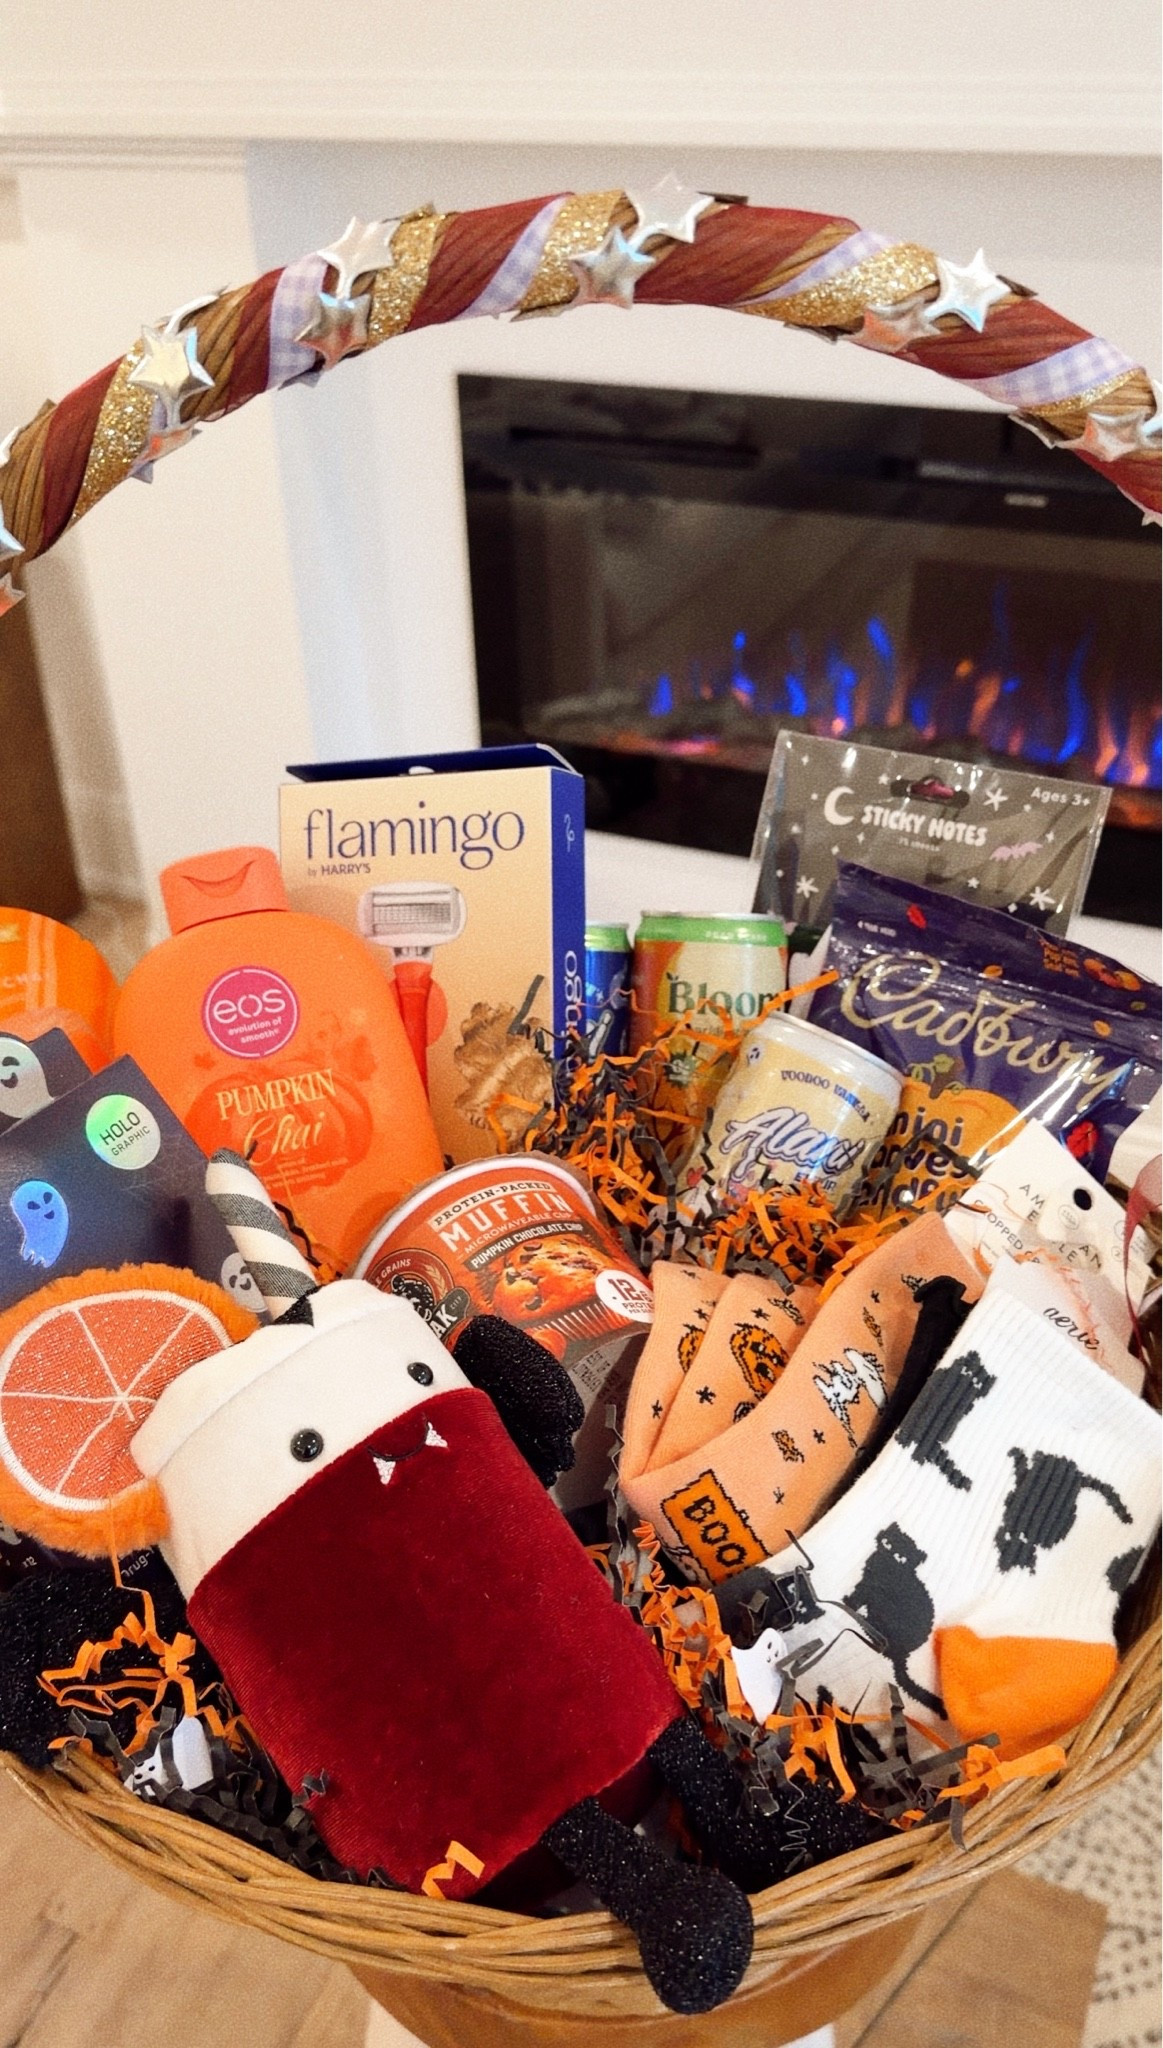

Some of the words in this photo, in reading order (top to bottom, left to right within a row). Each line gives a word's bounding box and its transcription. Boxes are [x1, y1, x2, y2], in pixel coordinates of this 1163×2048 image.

[1031, 786, 1067, 803] Ages
[1071, 795, 1090, 807] 3+
[303, 800, 525, 871] flamingo
[861, 804, 926, 834] STICKY
[928, 817, 989, 847] NOTES
[307, 867, 318, 877] by
[321, 863, 371, 876] HARRY'S
[213, 989, 286, 1024] eos
[228, 1020, 271, 1036] evolution
[272, 1016, 282, 1026] of
[841, 952, 1132, 1113] Cadbury
[216, 1068, 336, 1121] PUMPKIN
[781, 1069, 830, 1090] VOODOO
[99, 1111, 141, 1146] HOLO
[111, 1125, 151, 1156] GRAPHIC
[244, 1111, 325, 1166] Chai
[433, 1181, 551, 1226] PROTEIN-PACKED
[439, 1192, 574, 1253] MUFFIN
[974, 1199, 1023, 1250] COPPED
[464, 1211, 551, 1254] MICROWAVEABLE
[470, 1237, 514, 1269] PUMPKIN
[514, 1224, 568, 1243] CHOCOLATE
[381, 1258, 412, 1278] GRAINS
[683, 1494, 748, 1568] BOO
